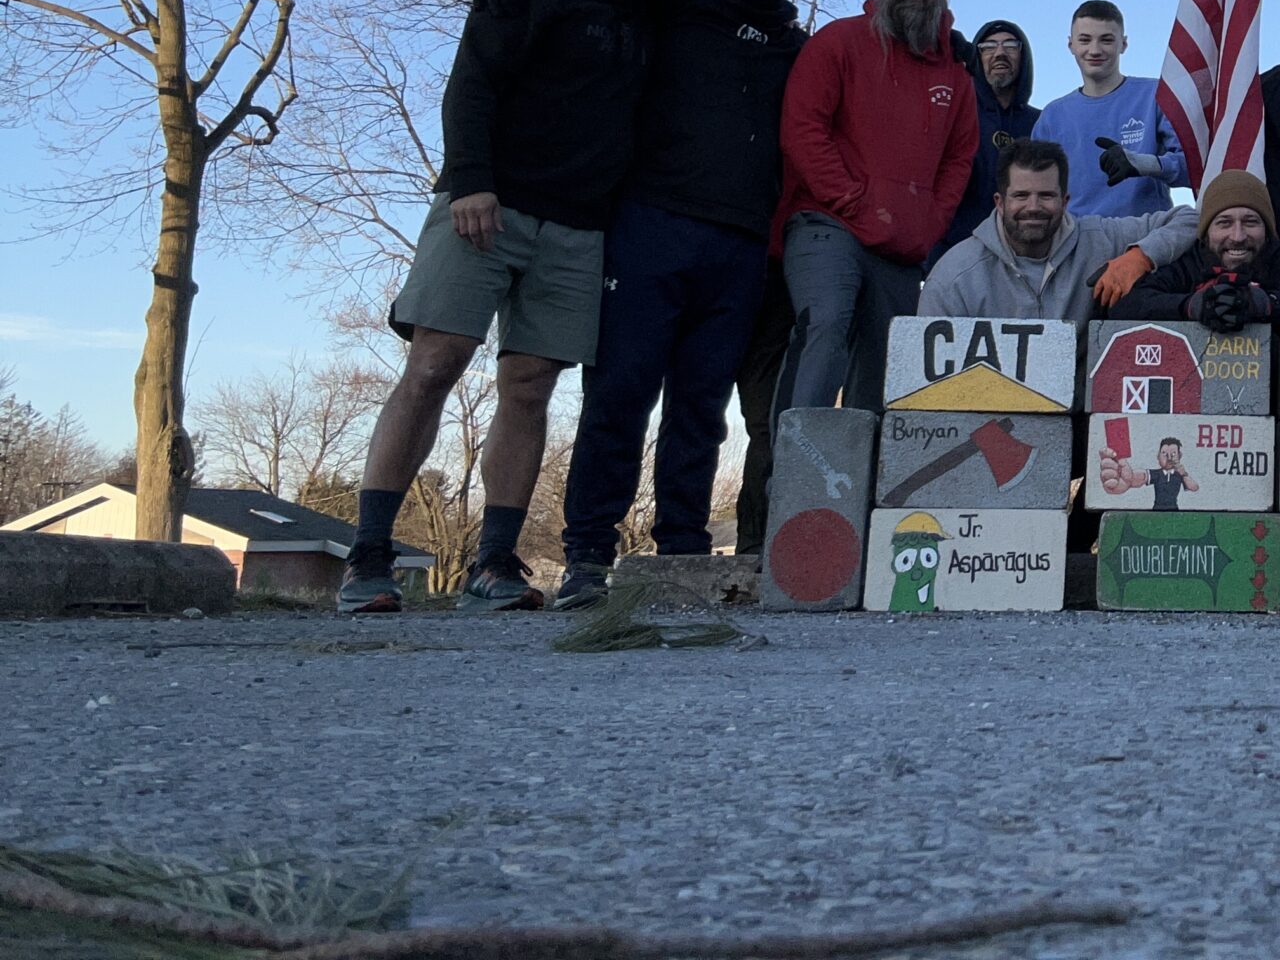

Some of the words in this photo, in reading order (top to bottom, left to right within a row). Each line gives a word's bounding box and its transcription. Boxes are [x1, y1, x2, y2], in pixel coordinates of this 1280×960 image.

[923, 320, 1045, 383] CAT
[1205, 336, 1259, 357] BARN
[1204, 360, 1260, 380] DOOR
[892, 416, 959, 450] Bunyan
[1196, 424, 1243, 448] RED
[1214, 450, 1268, 476] CARD
[959, 514, 982, 538] Jr.
[948, 549, 1050, 584] Asparagus
[1120, 544, 1218, 577] DOUBLEMINT
